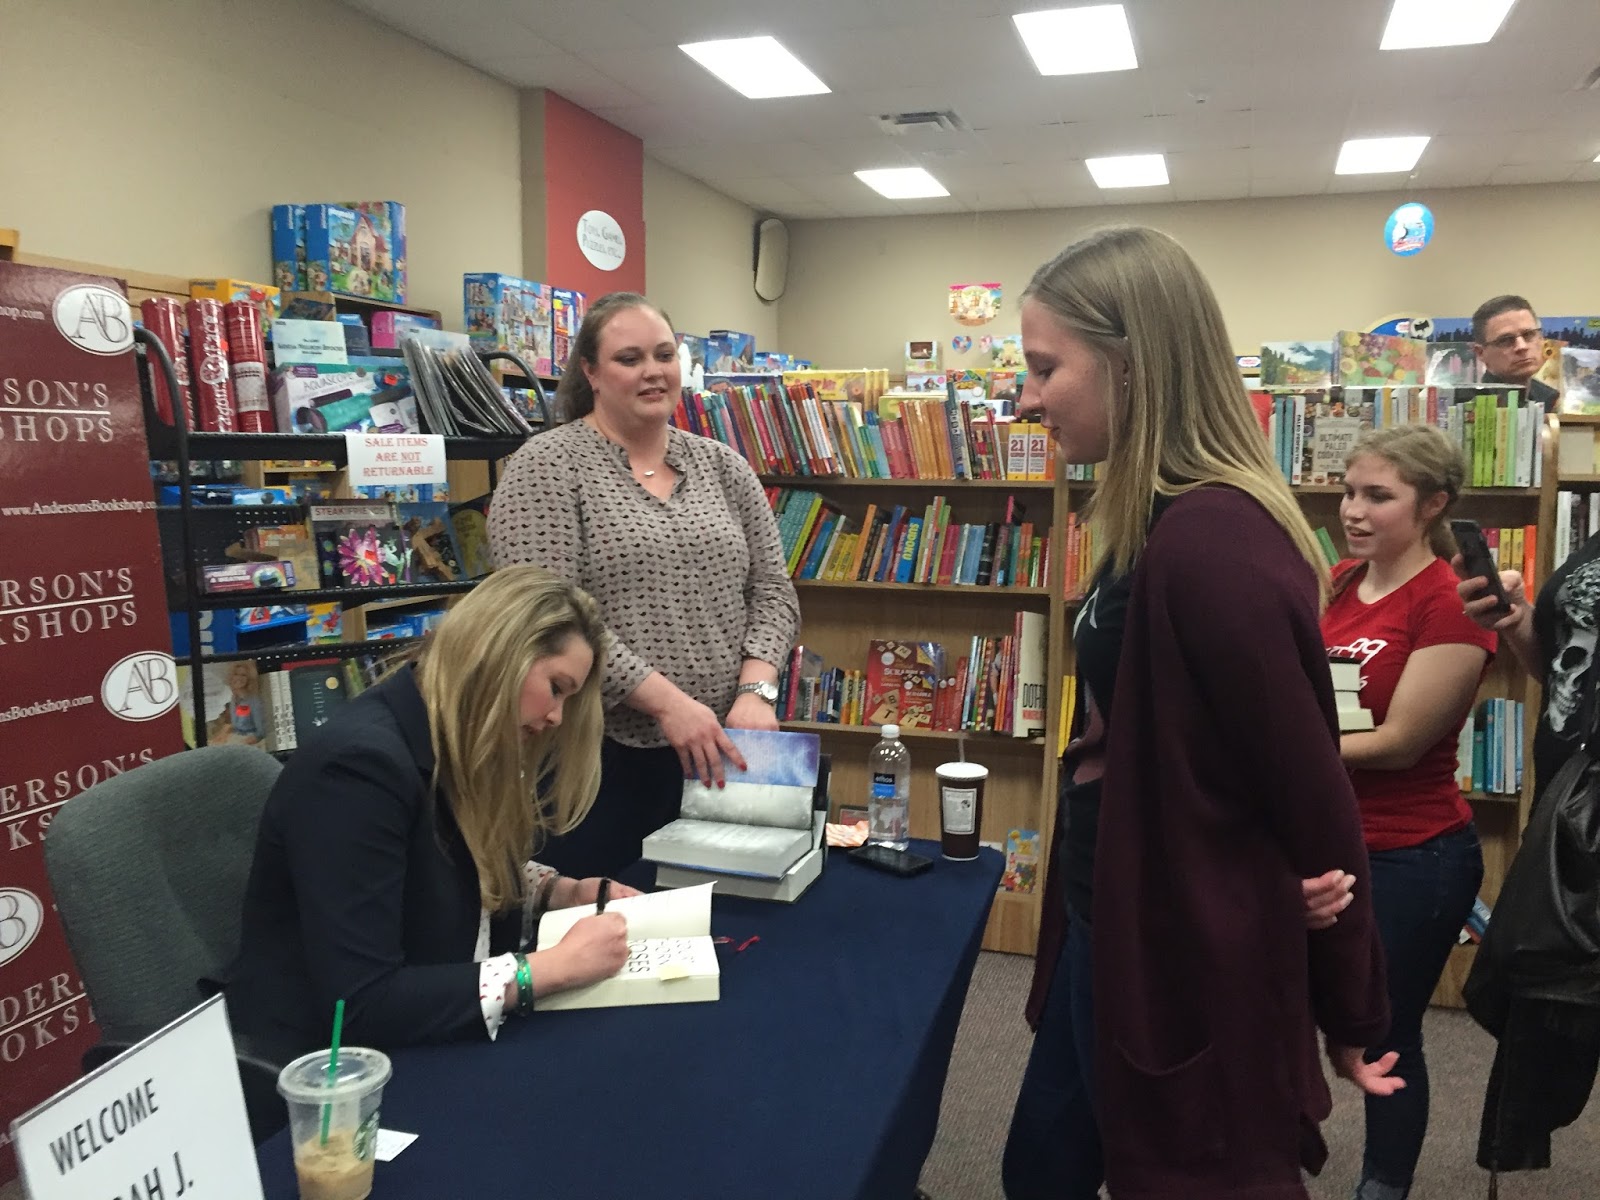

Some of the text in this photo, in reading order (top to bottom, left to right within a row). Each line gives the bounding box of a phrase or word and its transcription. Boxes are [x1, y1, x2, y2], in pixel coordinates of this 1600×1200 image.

[0, 415, 114, 443] HOPS
[365, 438, 428, 447] SALE ITEMS
[1011, 439, 1024, 452] 21
[1031, 439, 1045, 452] 21
[376, 452, 421, 462] ARE NOT
[363, 466, 434, 476] RETURNABLE
[902, 522, 920, 560] SUDOKU
[49, 1078, 159, 1176] WELCOME
[111, 1151, 194, 1200] AH J.
